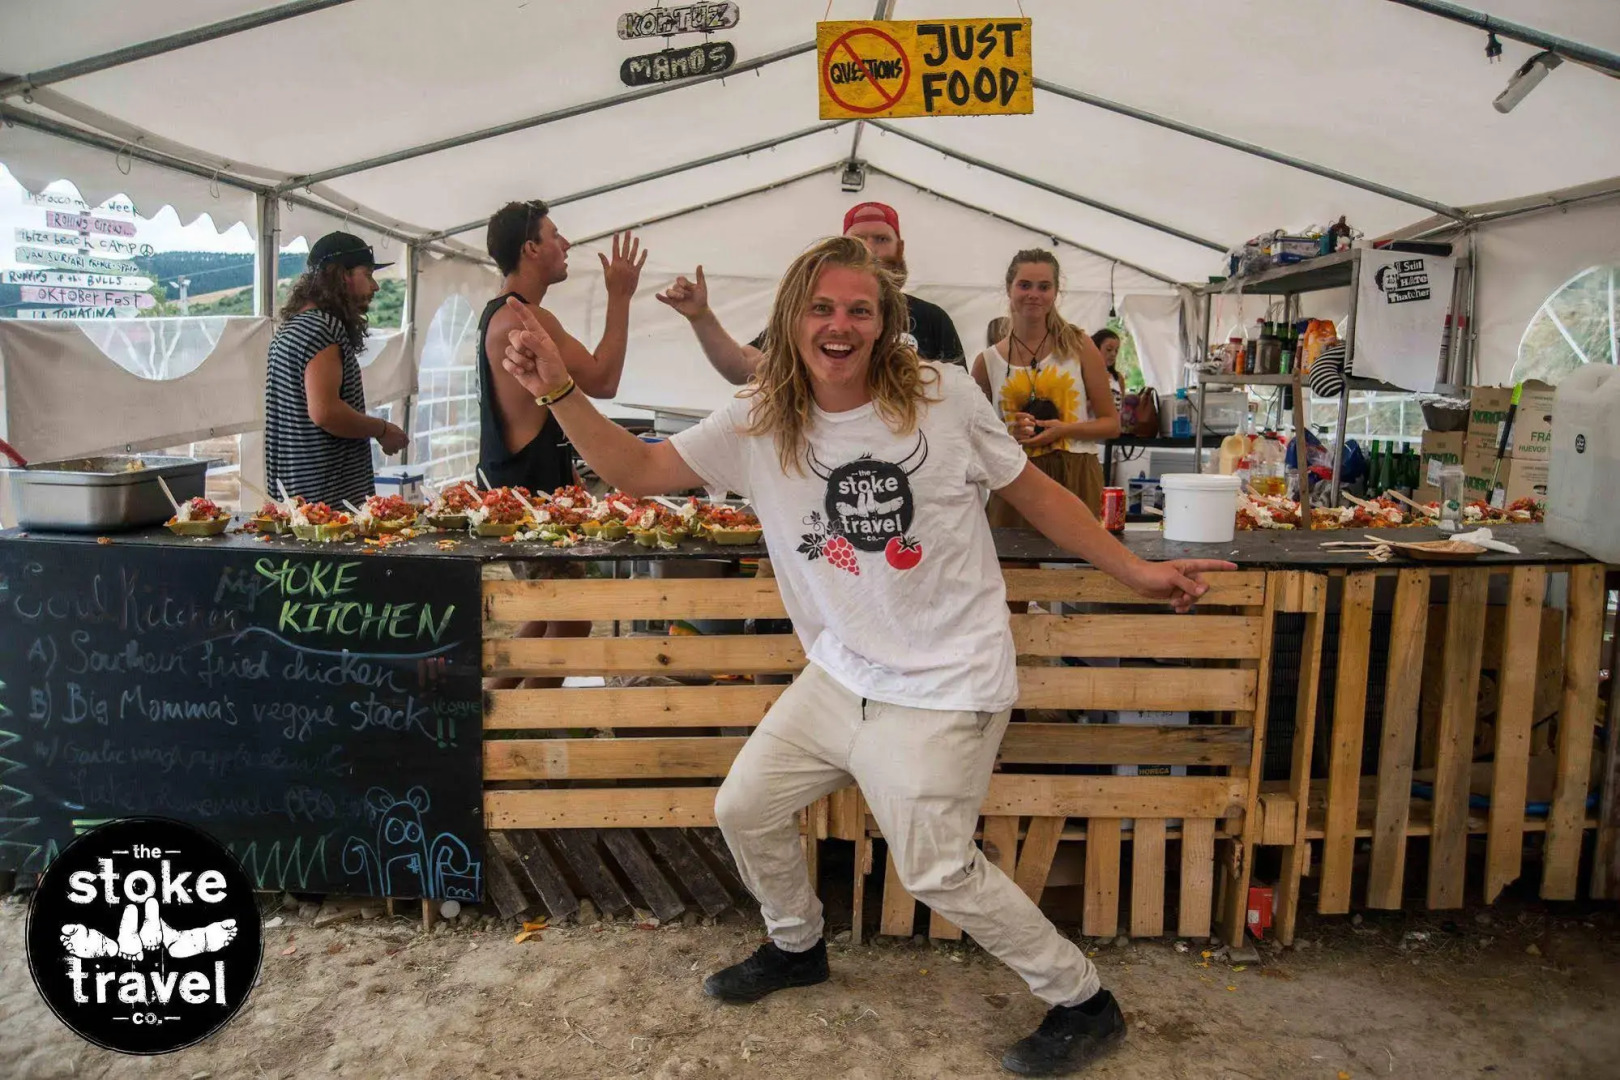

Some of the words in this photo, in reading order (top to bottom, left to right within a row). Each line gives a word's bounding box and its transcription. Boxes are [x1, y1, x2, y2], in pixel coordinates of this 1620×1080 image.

[917, 23, 1022, 67] JUST
[830, 58, 903, 84] QUESTIONS
[922, 67, 1019, 113] FOOD
[1388, 289, 1430, 302] Thatcher
[838, 475, 899, 495] stoke
[840, 514, 902, 534] travel
[278, 600, 456, 644] KITCHEN
[283, 648, 408, 693] chicken
[61, 681, 109, 726] Big
[350, 692, 438, 741] stack
